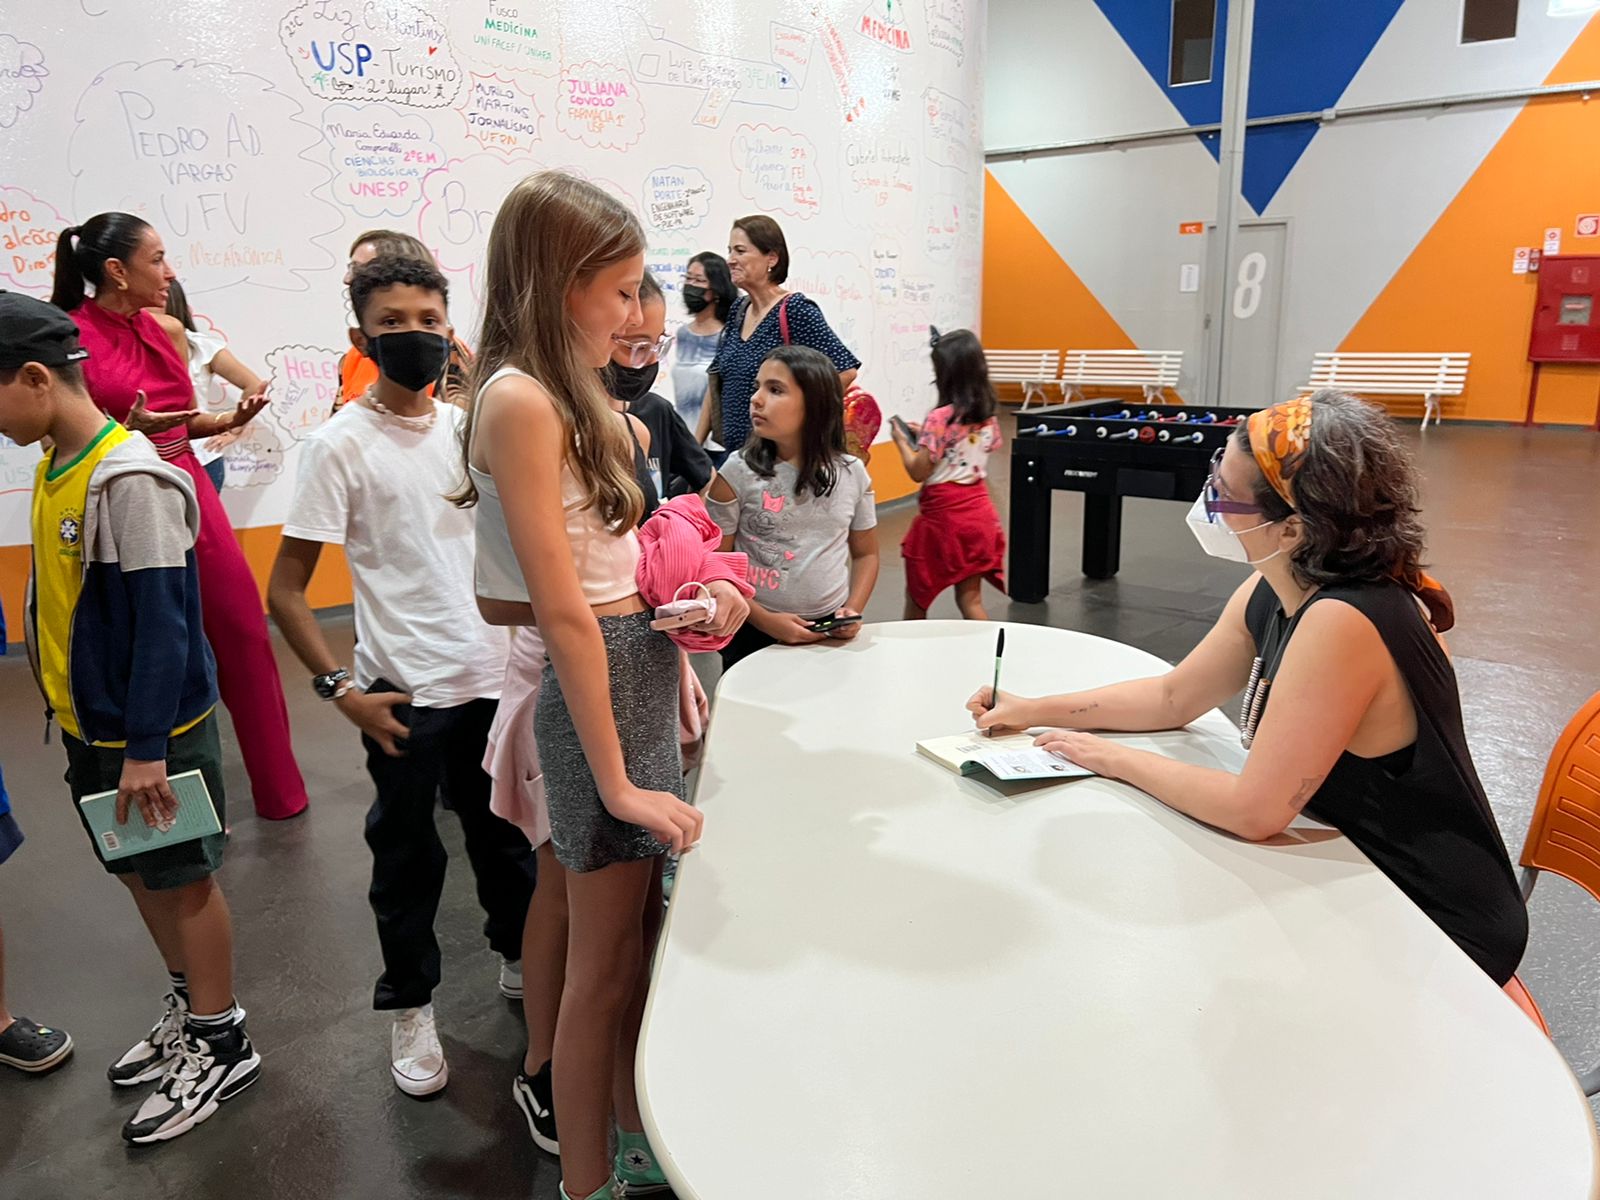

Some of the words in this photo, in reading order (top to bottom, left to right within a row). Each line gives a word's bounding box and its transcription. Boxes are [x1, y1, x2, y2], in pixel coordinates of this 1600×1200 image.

[311, 40, 372, 77] USP
[567, 79, 629, 97] JULIANA
[115, 90, 209, 160] PEDRO
[160, 162, 238, 185] VARGAS
[349, 180, 409, 197] UNESP
[651, 176, 685, 188] NATAN
[160, 192, 250, 237] UFV
[1233, 252, 1267, 319] 8
